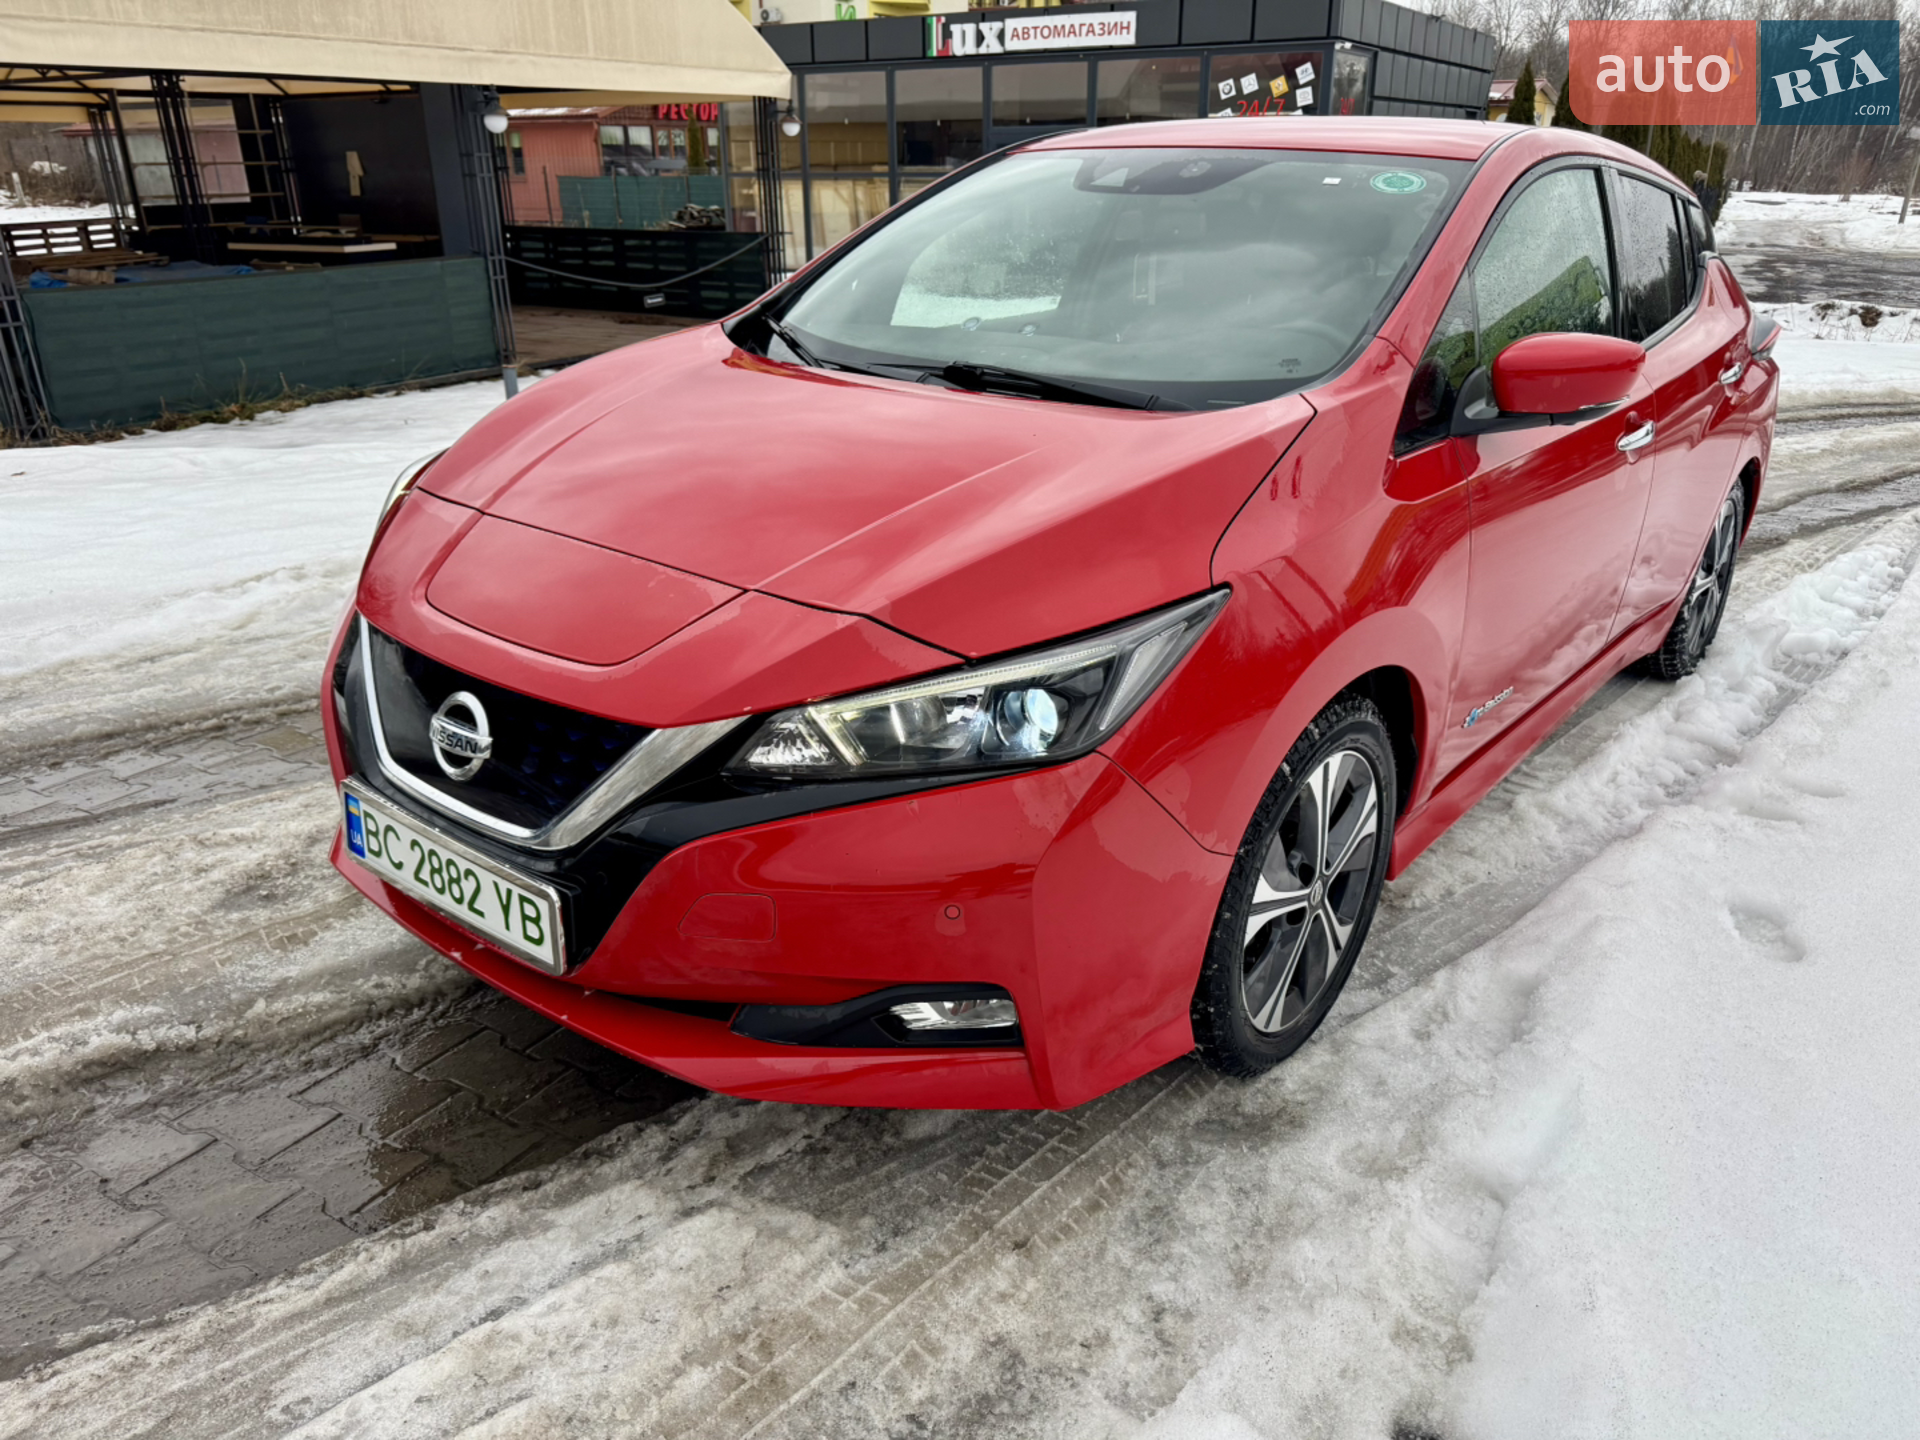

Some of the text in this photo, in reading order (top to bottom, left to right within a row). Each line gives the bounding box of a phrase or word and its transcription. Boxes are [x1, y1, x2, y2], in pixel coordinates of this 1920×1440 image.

[927, 16, 1004, 57] Lux
[1010, 21, 1132, 42] АВТОМАГАЗИН
[1237, 96, 1286, 117] 24/7
[432, 721, 479, 755] NISSAN
[350, 829, 364, 848] UA
[363, 810, 545, 947] BC 2882 YB
